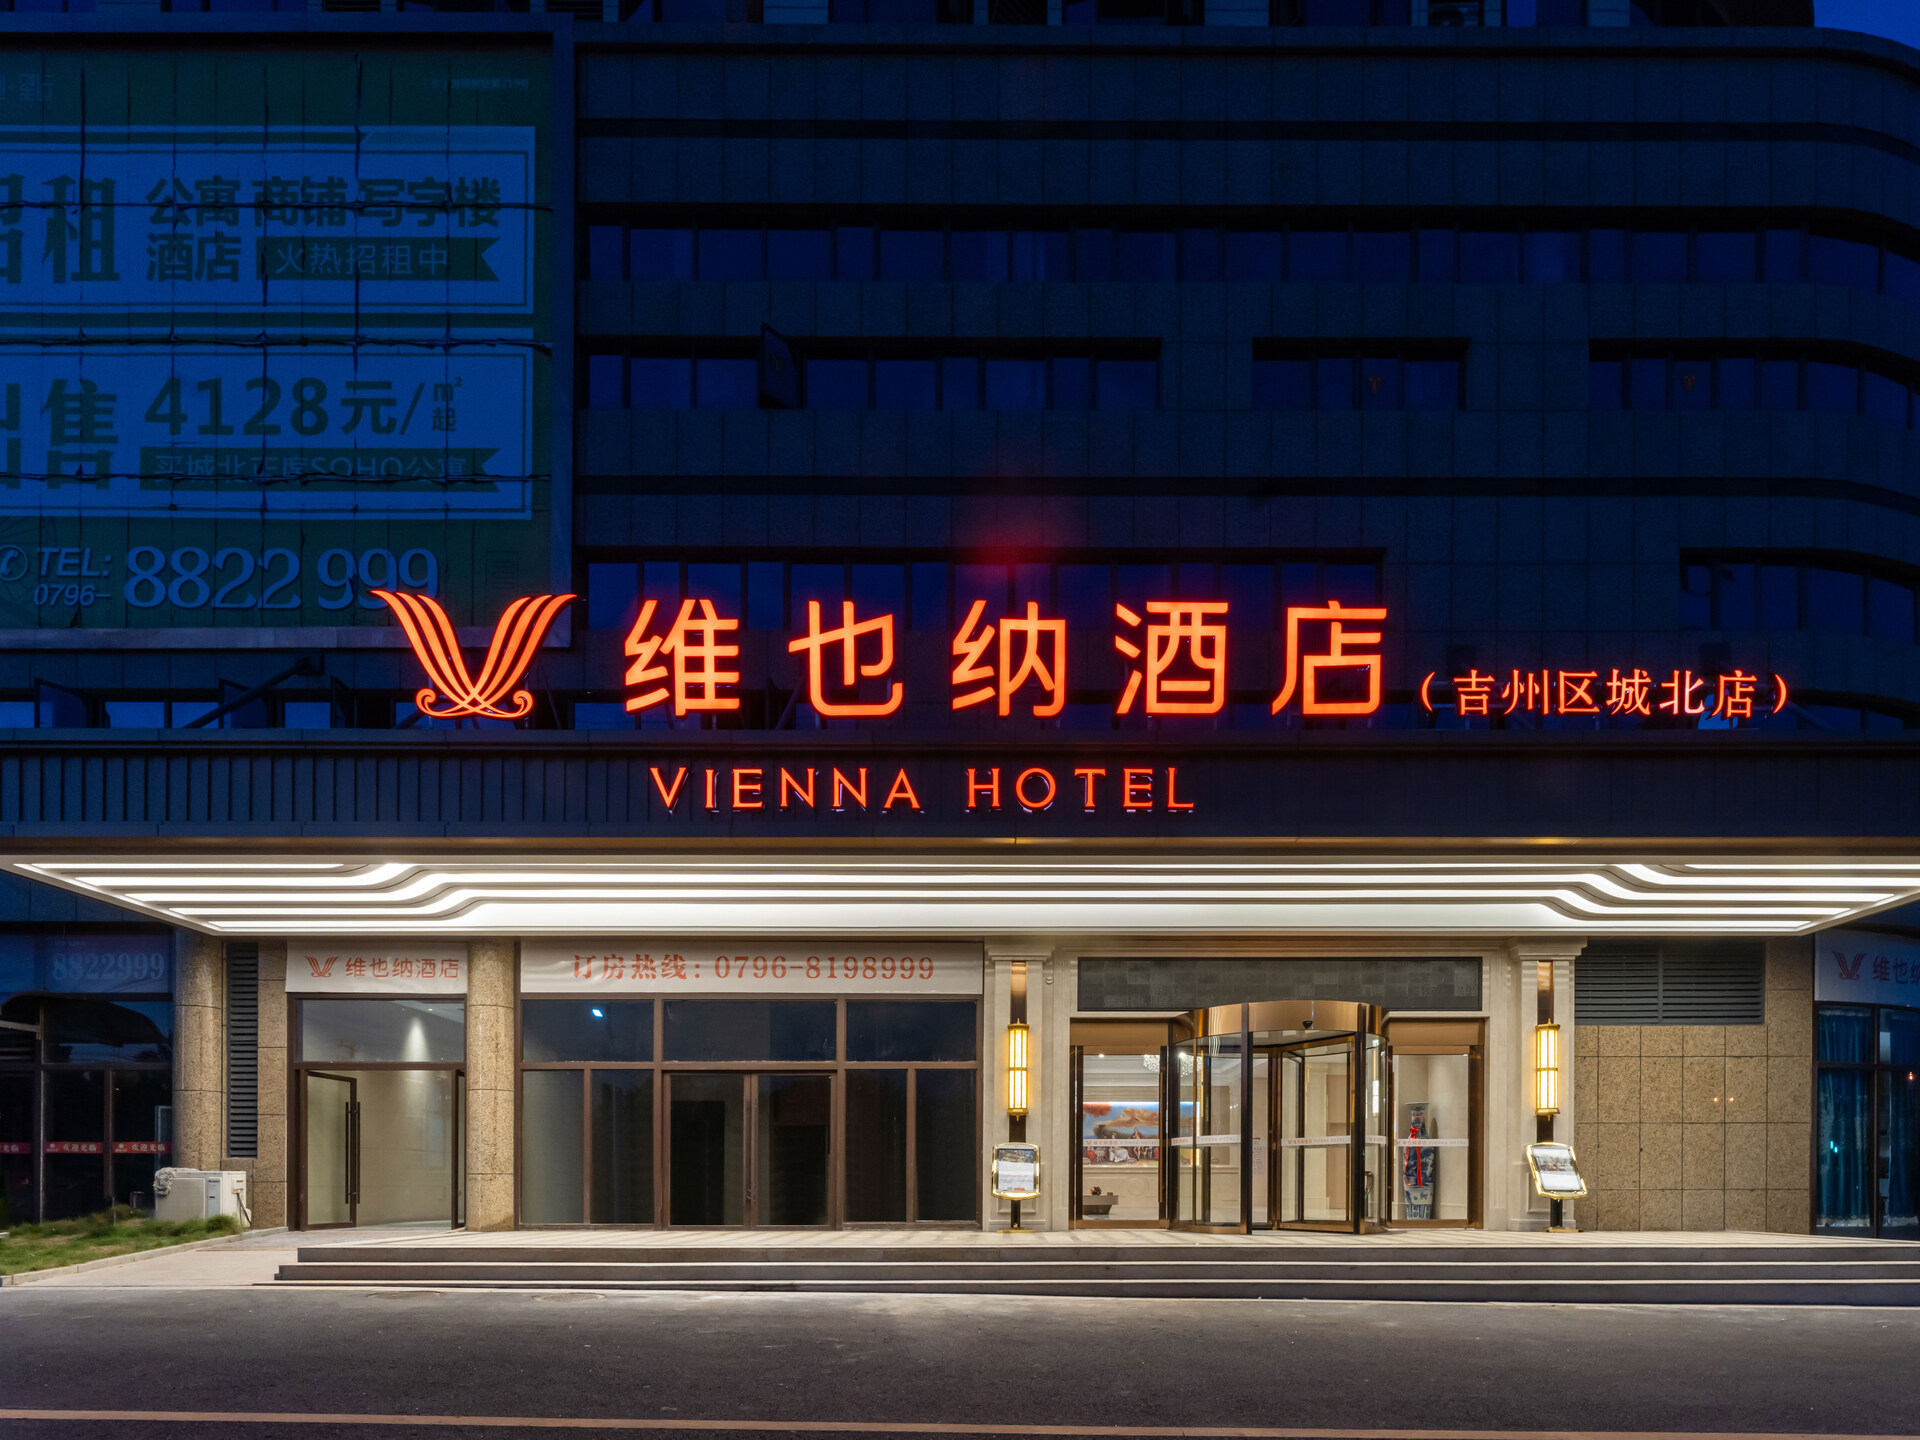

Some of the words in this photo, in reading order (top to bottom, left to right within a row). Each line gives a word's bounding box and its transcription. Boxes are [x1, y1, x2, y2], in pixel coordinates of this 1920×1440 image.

[146, 177, 240, 228] 公寓
[253, 176, 348, 228] 商铺
[358, 177, 501, 228] 写字楼
[146, 232, 241, 283] 酒店
[275, 243, 450, 277] 火热招租中
[0, 378, 118, 490] 售
[37, 547, 110, 577] TEL:
[624, 599, 1388, 718] 维也纳酒店
[649, 766, 922, 812] VIENNA
[966, 766, 1196, 812] HOTEL
[52, 952, 165, 981] 8822999
[345, 957, 460, 979] 维也纳酒店
[131, 1143, 166, 1152] 欢迎光临
